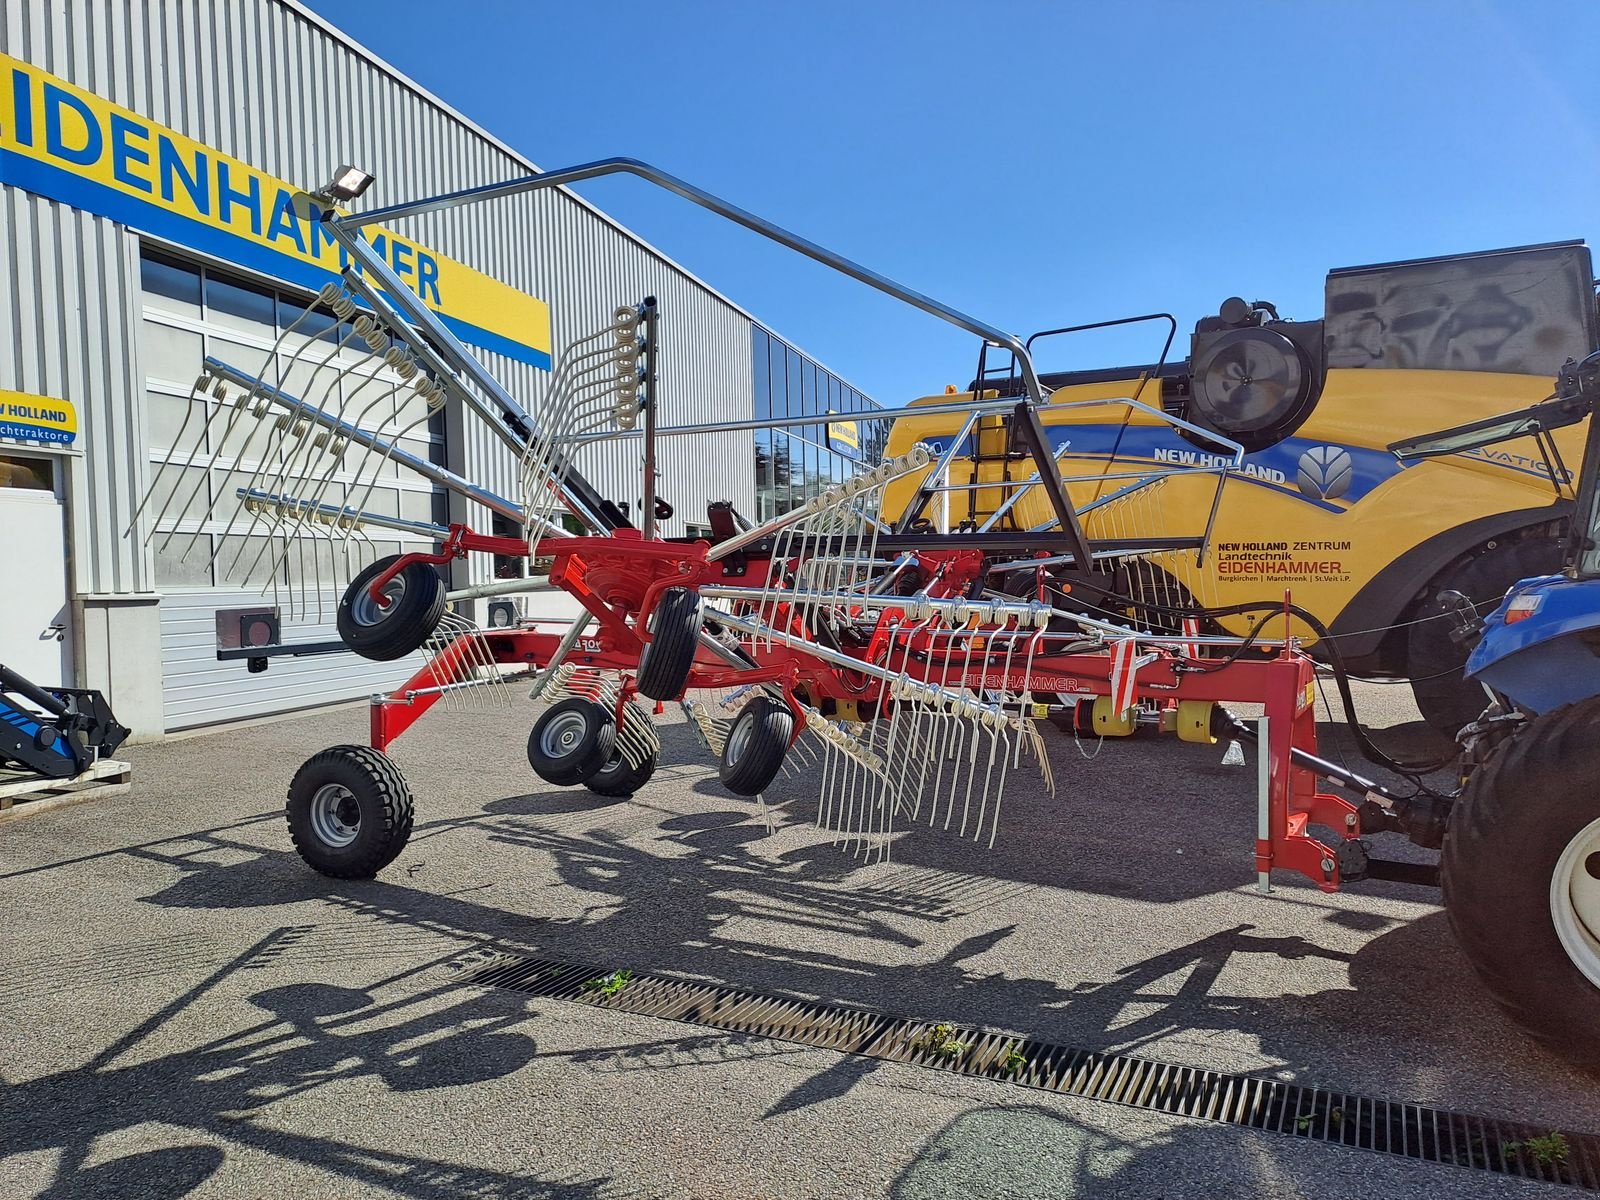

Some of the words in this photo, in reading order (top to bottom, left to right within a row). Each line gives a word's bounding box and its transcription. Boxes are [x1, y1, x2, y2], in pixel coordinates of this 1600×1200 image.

[0, 68, 442, 306] IDENHAMMER
[8, 404, 67, 423] HOLLAND
[1154, 448, 1196, 465] NEW
[1218, 543, 1240, 551] NEW
[1243, 542, 1288, 551] HOLLAND
[1293, 541, 1351, 551] ZENTRUM
[1218, 552, 1292, 561] Landtechnik
[1218, 561, 1342, 574] EIDENHAMMER
[961, 673, 1079, 691] EIDENHAMMER
